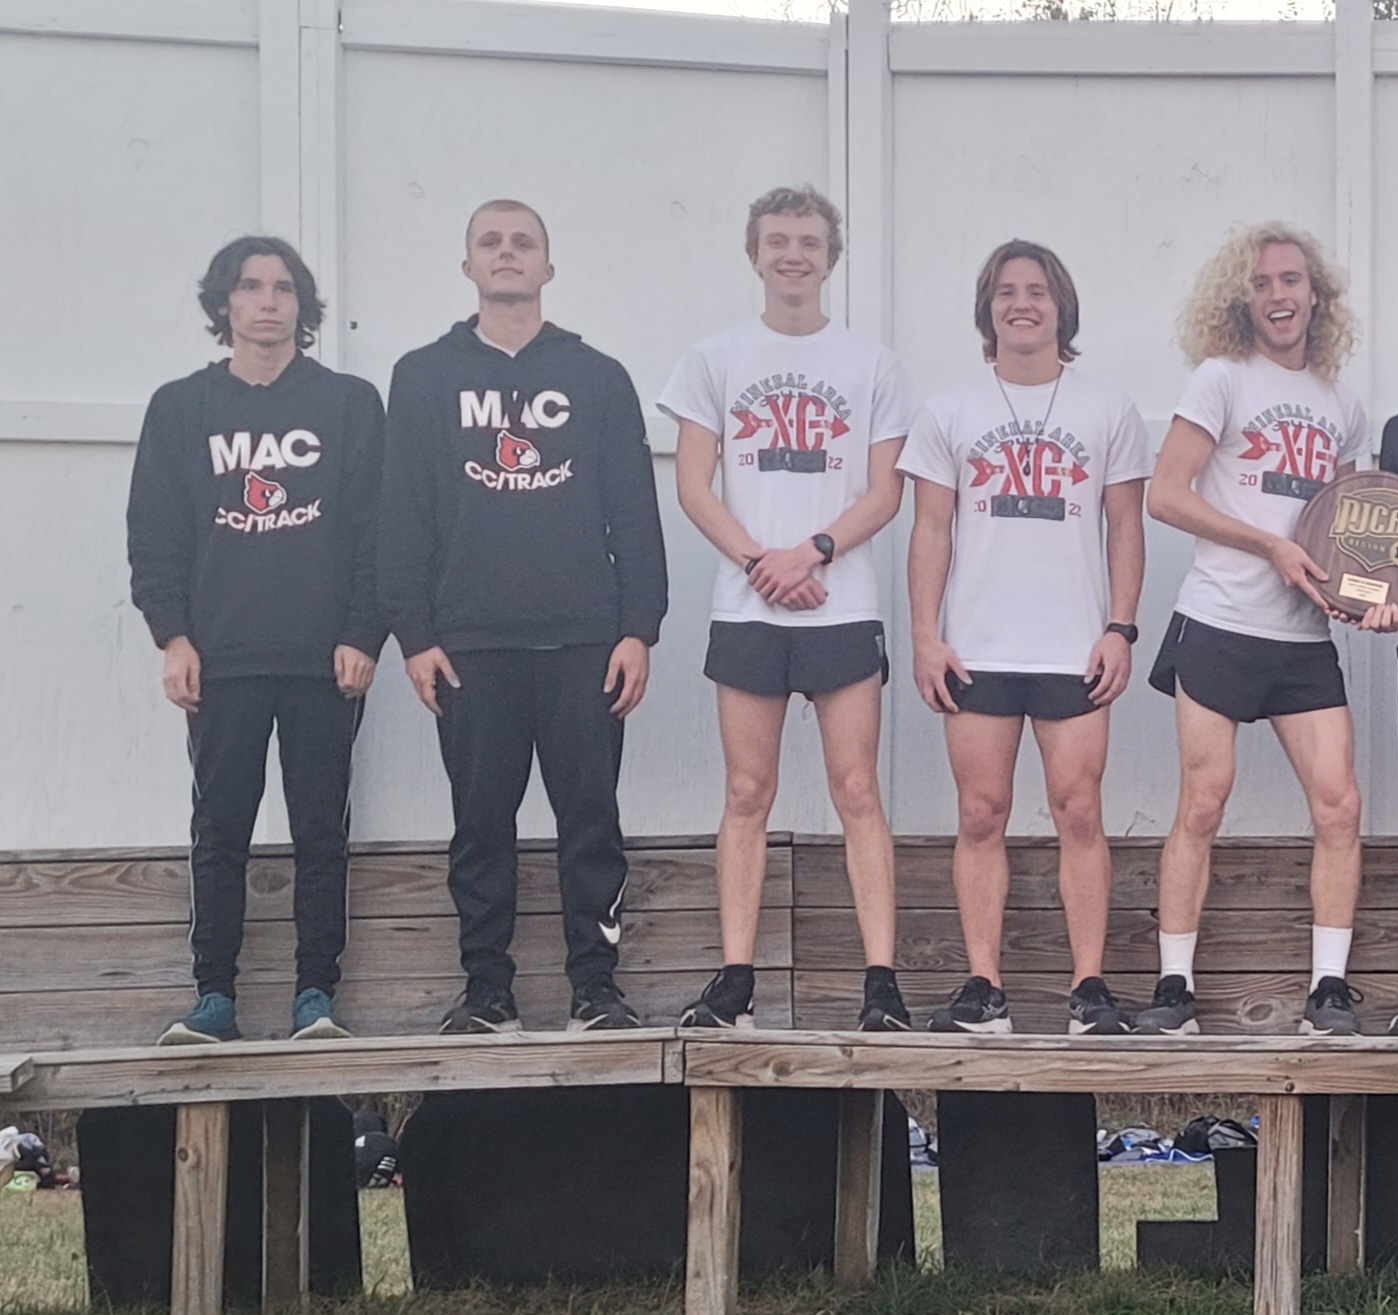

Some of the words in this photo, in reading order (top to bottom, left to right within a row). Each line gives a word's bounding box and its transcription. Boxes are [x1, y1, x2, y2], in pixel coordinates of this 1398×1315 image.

[208, 428, 322, 475] MAC
[463, 459, 574, 490] CC/TRACK
[1239, 473, 1257, 486] 20
